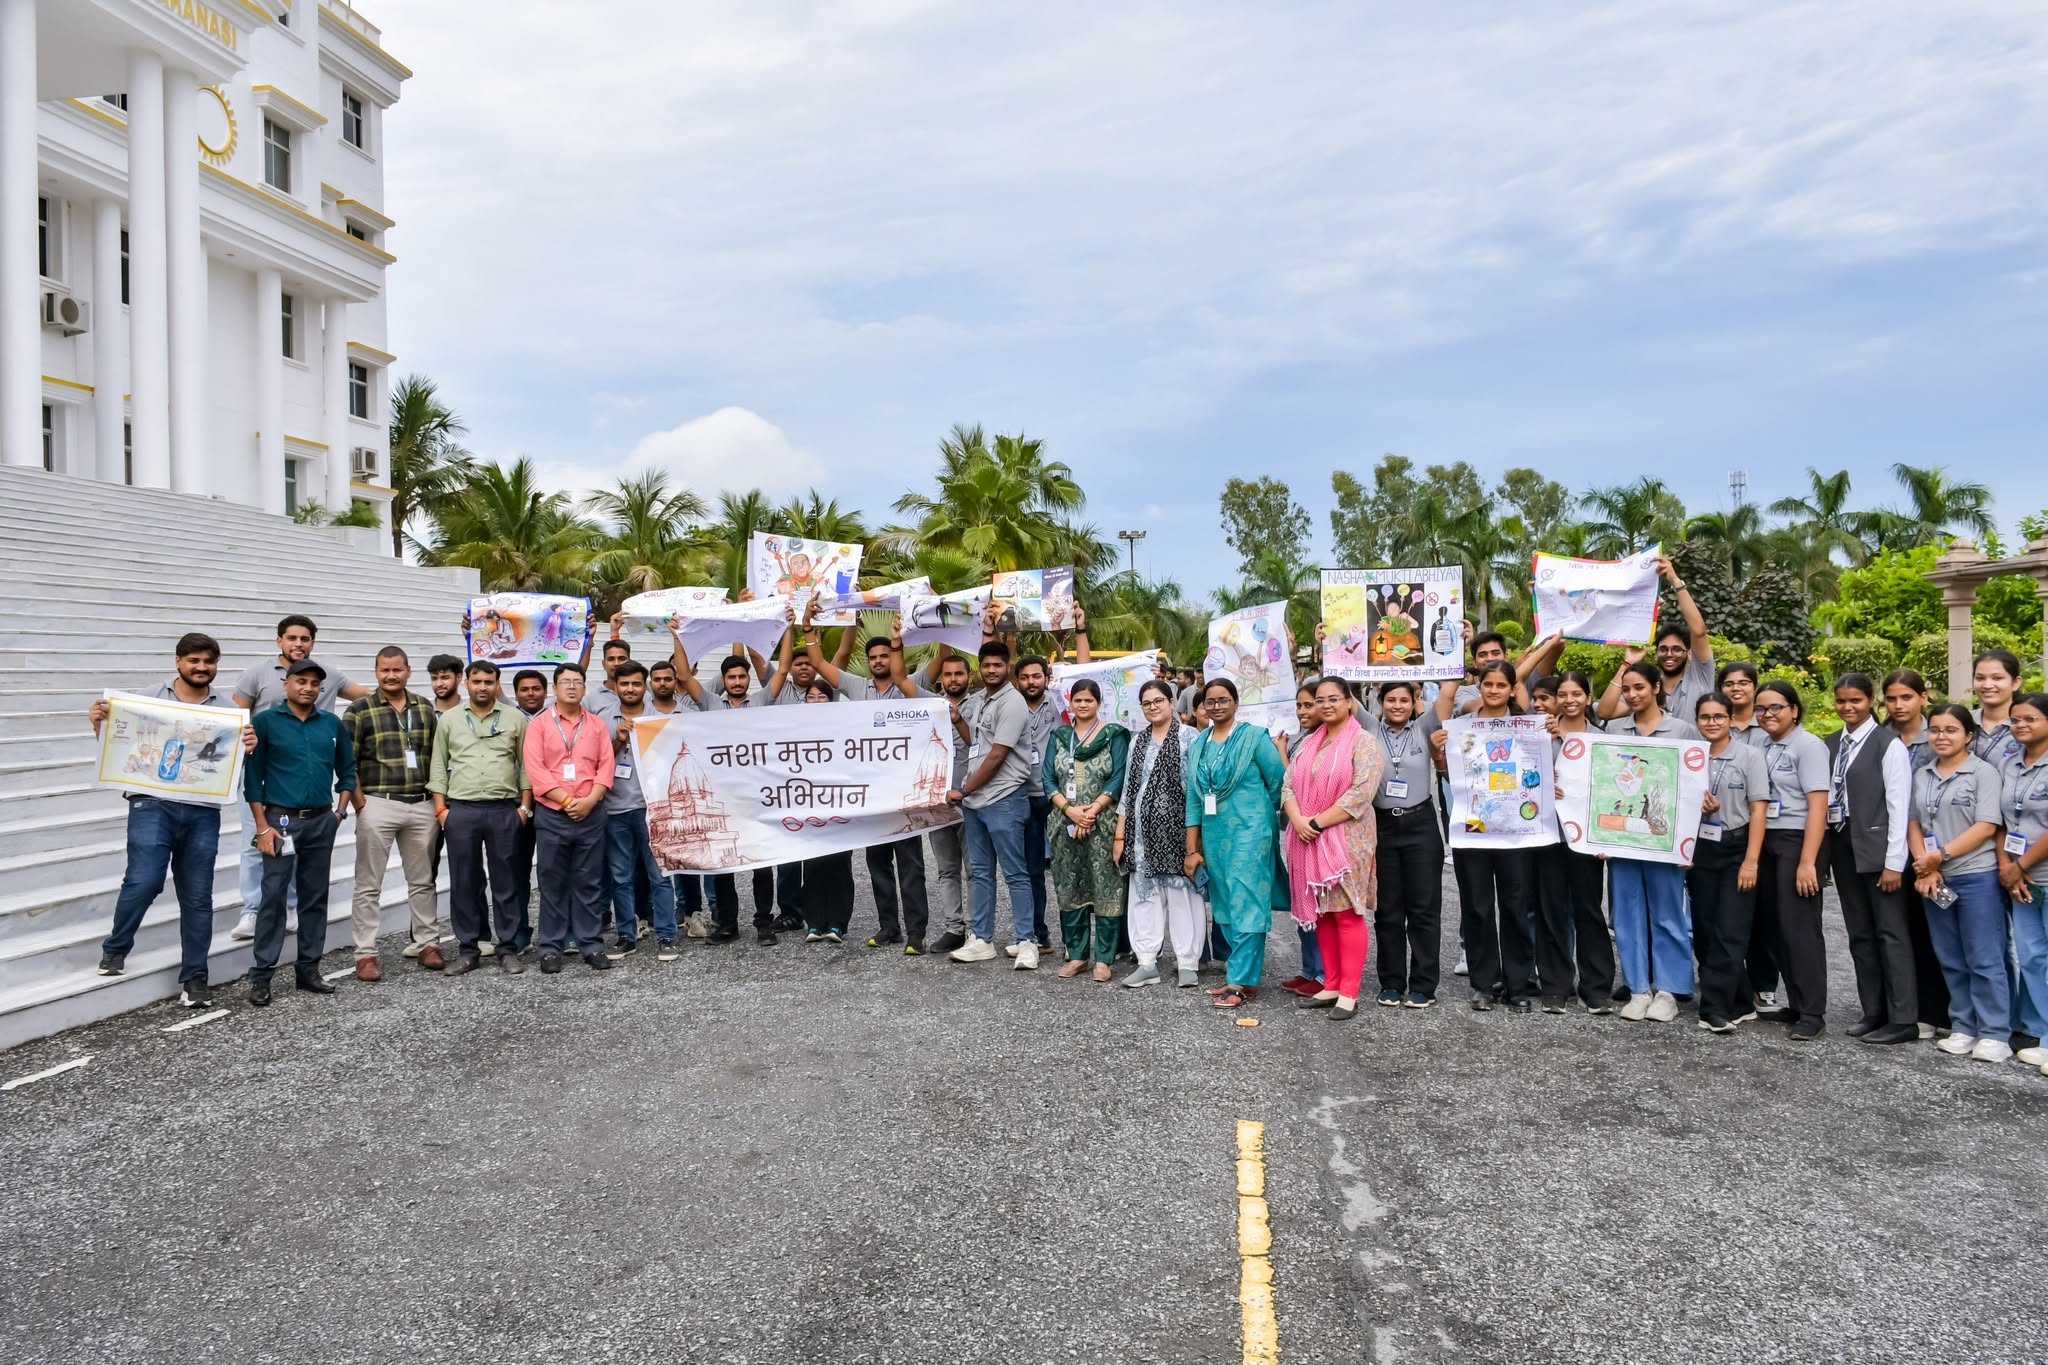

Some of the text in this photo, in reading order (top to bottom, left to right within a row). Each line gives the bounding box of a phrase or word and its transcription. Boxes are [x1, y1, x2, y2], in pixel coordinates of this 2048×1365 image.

[1328, 566, 1461, 585] NASHA MUKTI ABHIYAN
[887, 710, 930, 719] ASHOKA
[706, 736, 911, 774] नशा मुक्त भारत
[760, 778, 870, 809] अभियान
